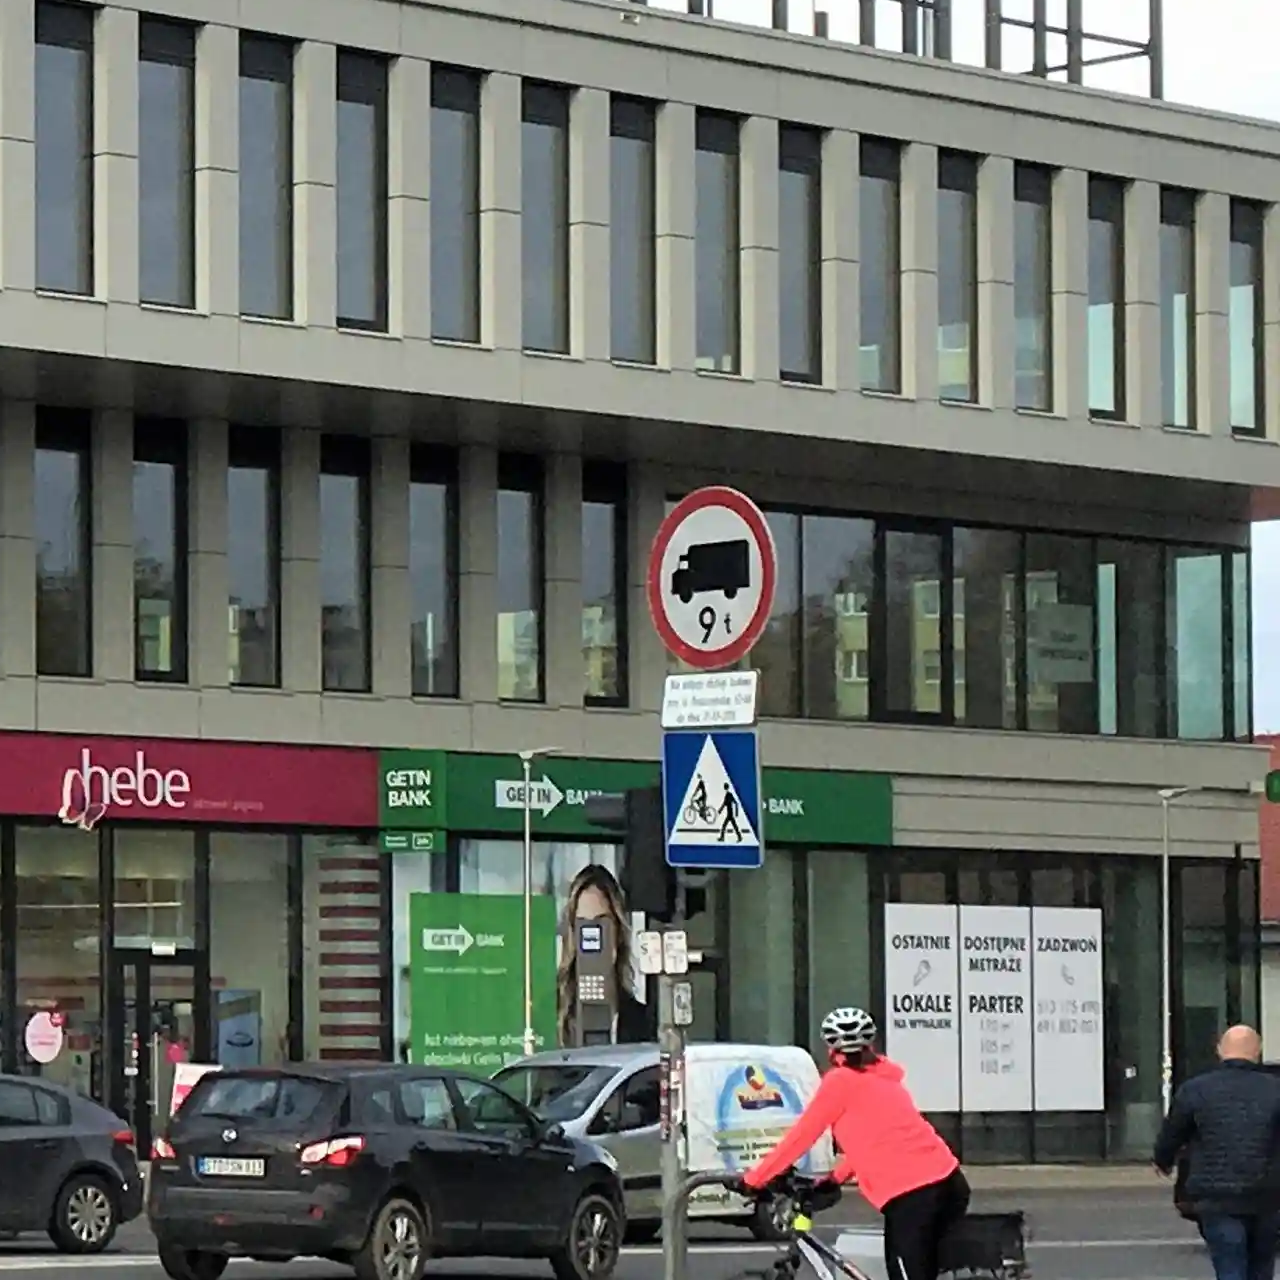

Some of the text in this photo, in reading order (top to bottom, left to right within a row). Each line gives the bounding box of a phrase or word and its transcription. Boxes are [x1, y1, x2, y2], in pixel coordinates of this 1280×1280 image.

[74, 748, 190, 812] hebe
[386, 770, 431, 787] GETIN
[389, 790, 431, 807] BANK
[537, 788, 551, 803] IN
[768, 798, 805, 816] BANK
[891, 934, 951, 951] OSTATNIE
[964, 936, 1026, 953] DOSTĘPNE
[1038, 936, 1098, 953] ZADZWOŃ
[893, 994, 952, 1013] LOKALE
[969, 994, 1024, 1014] PARTER
